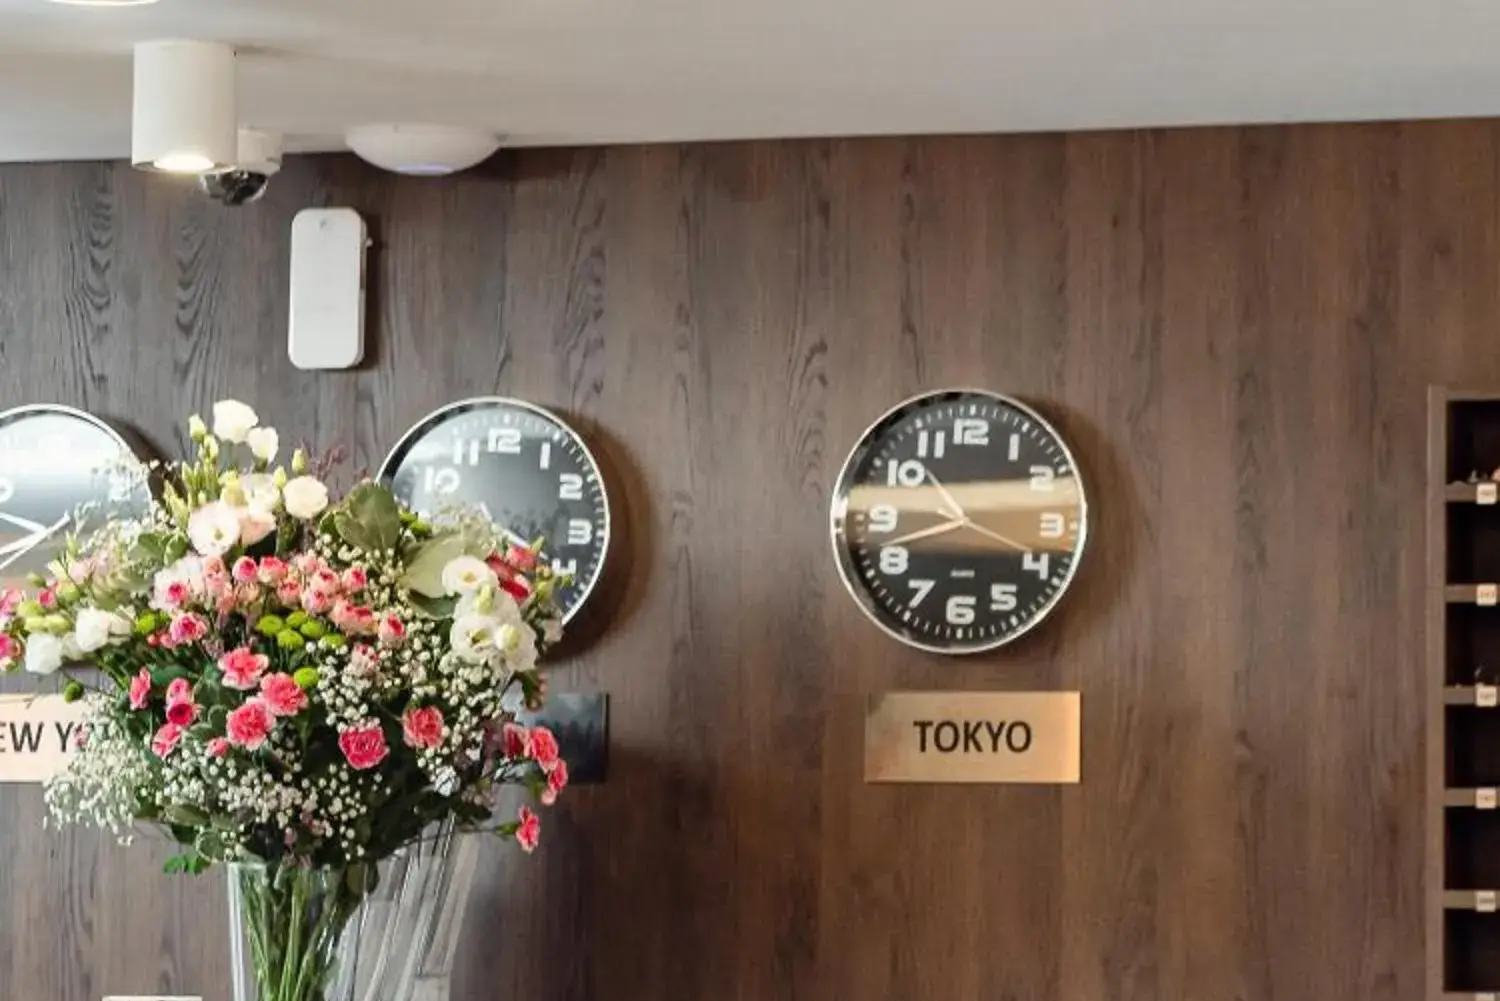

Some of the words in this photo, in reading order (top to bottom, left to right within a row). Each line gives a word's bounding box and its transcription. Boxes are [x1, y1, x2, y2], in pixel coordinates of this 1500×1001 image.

[486, 427, 522, 454] 12
[916, 430, 945, 458] 11
[953, 419, 990, 446] 12
[452, 438, 480, 467] 11
[540, 442, 551, 470] 1
[1008, 433, 1020, 461] 1
[423, 465, 461, 494] 10
[559, 472, 584, 500] 2
[887, 459, 925, 488] 10
[1028, 465, 1055, 491] 2
[567, 518, 593, 545] 3
[868, 504, 898, 532] 9
[1040, 513, 1066, 538] 3
[879, 546, 909, 574] 8
[1023, 552, 1049, 579] 4
[908, 579, 936, 608] 7
[991, 583, 1018, 612] 5
[946, 596, 977, 625] 6
[913, 720, 1033, 754] TOKYO
